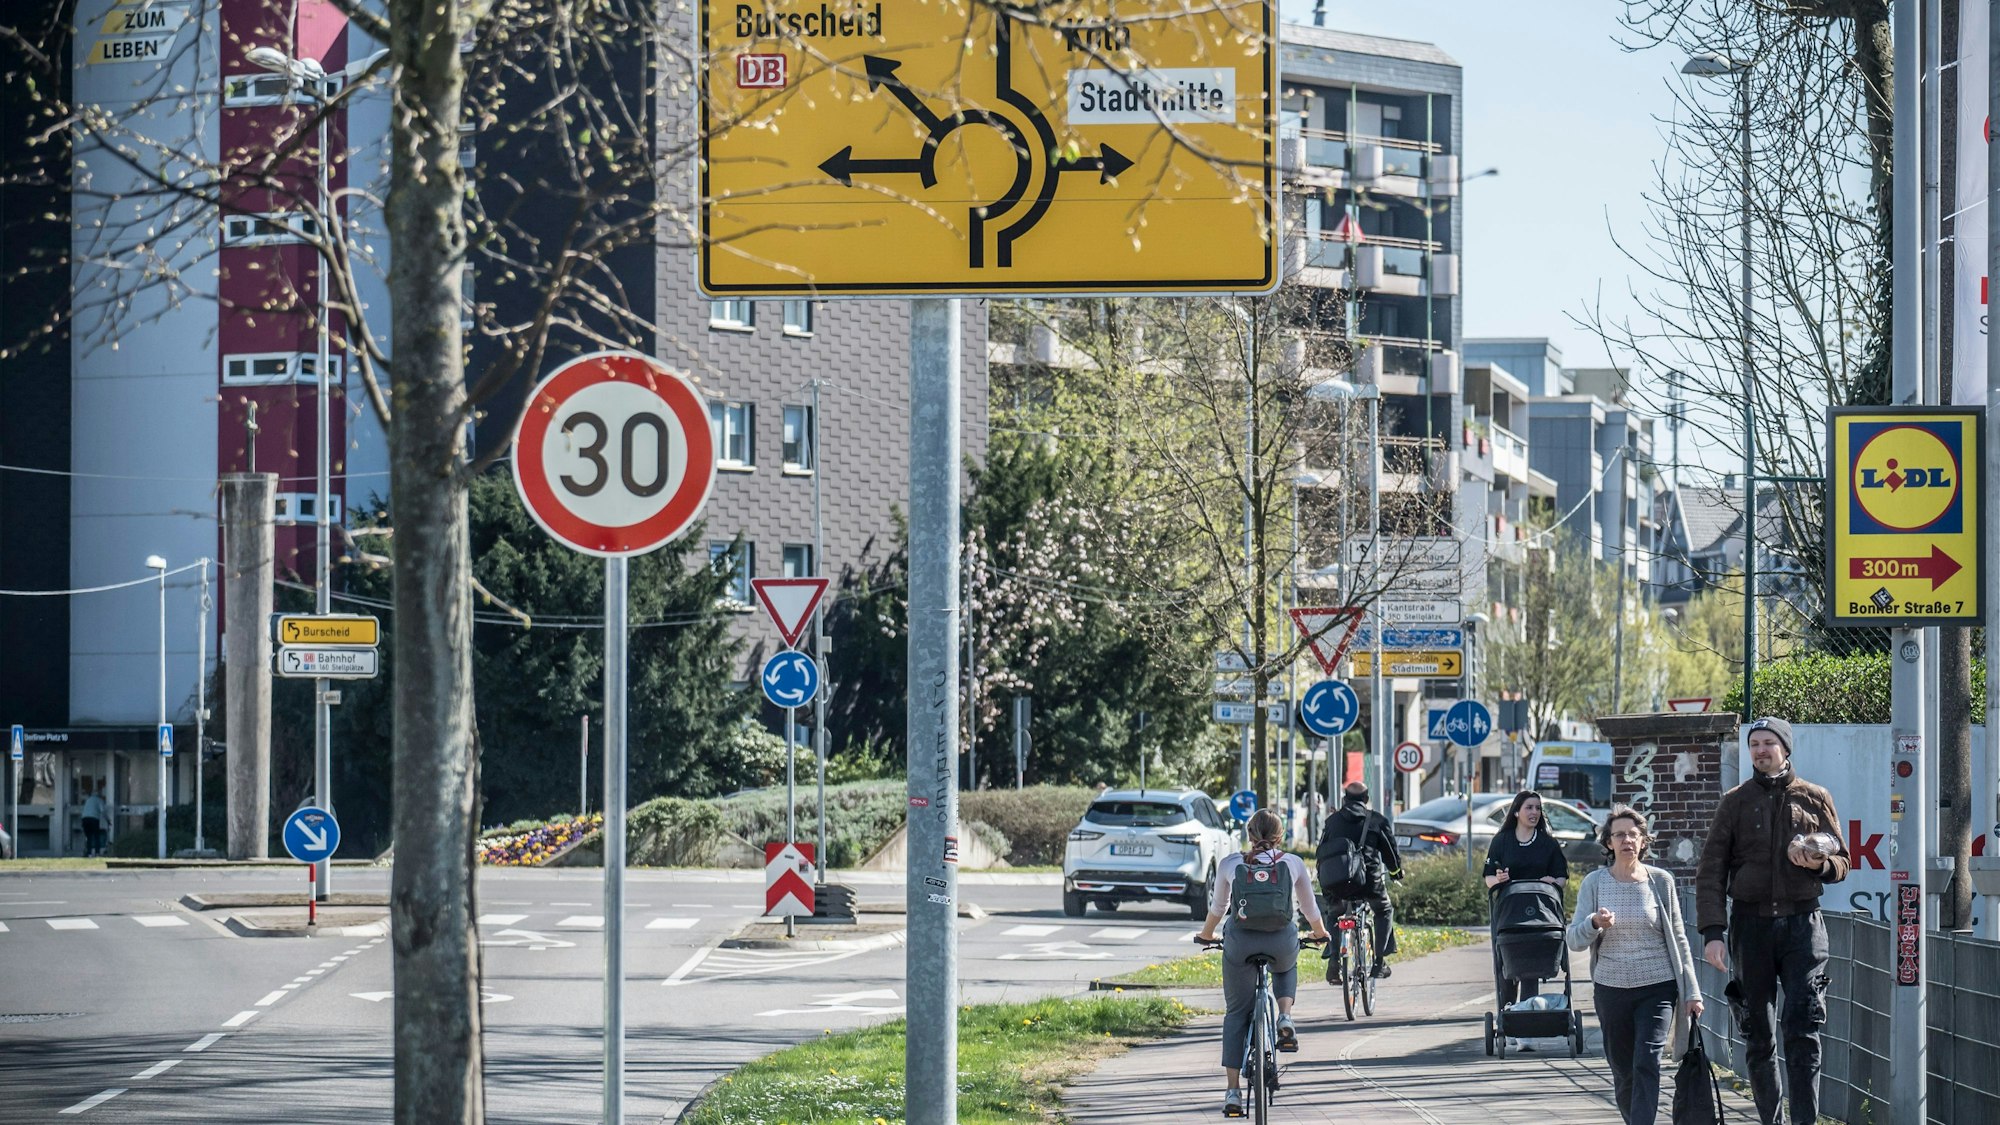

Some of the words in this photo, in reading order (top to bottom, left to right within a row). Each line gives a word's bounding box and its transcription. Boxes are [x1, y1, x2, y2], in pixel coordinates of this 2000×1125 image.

[125, 11, 166, 29] ZUM
[736, 3, 882, 38] Burscheid
[103, 40, 158, 59] LEBEN
[742, 59, 781, 83] DB
[1080, 80, 1224, 112] Stadtmitte
[559, 411, 670, 498] 30
[1862, 560, 1900, 577] 300
[1901, 562, 1919, 577] m
[1904, 602, 1951, 614] Straße
[1955, 602, 1964, 613] 7
[303, 627, 350, 637] Burscheid
[318, 653, 356, 663] Bahnhof
[1392, 664, 1438, 674] Stadtmitte
[1400, 750, 1418, 764] 30
